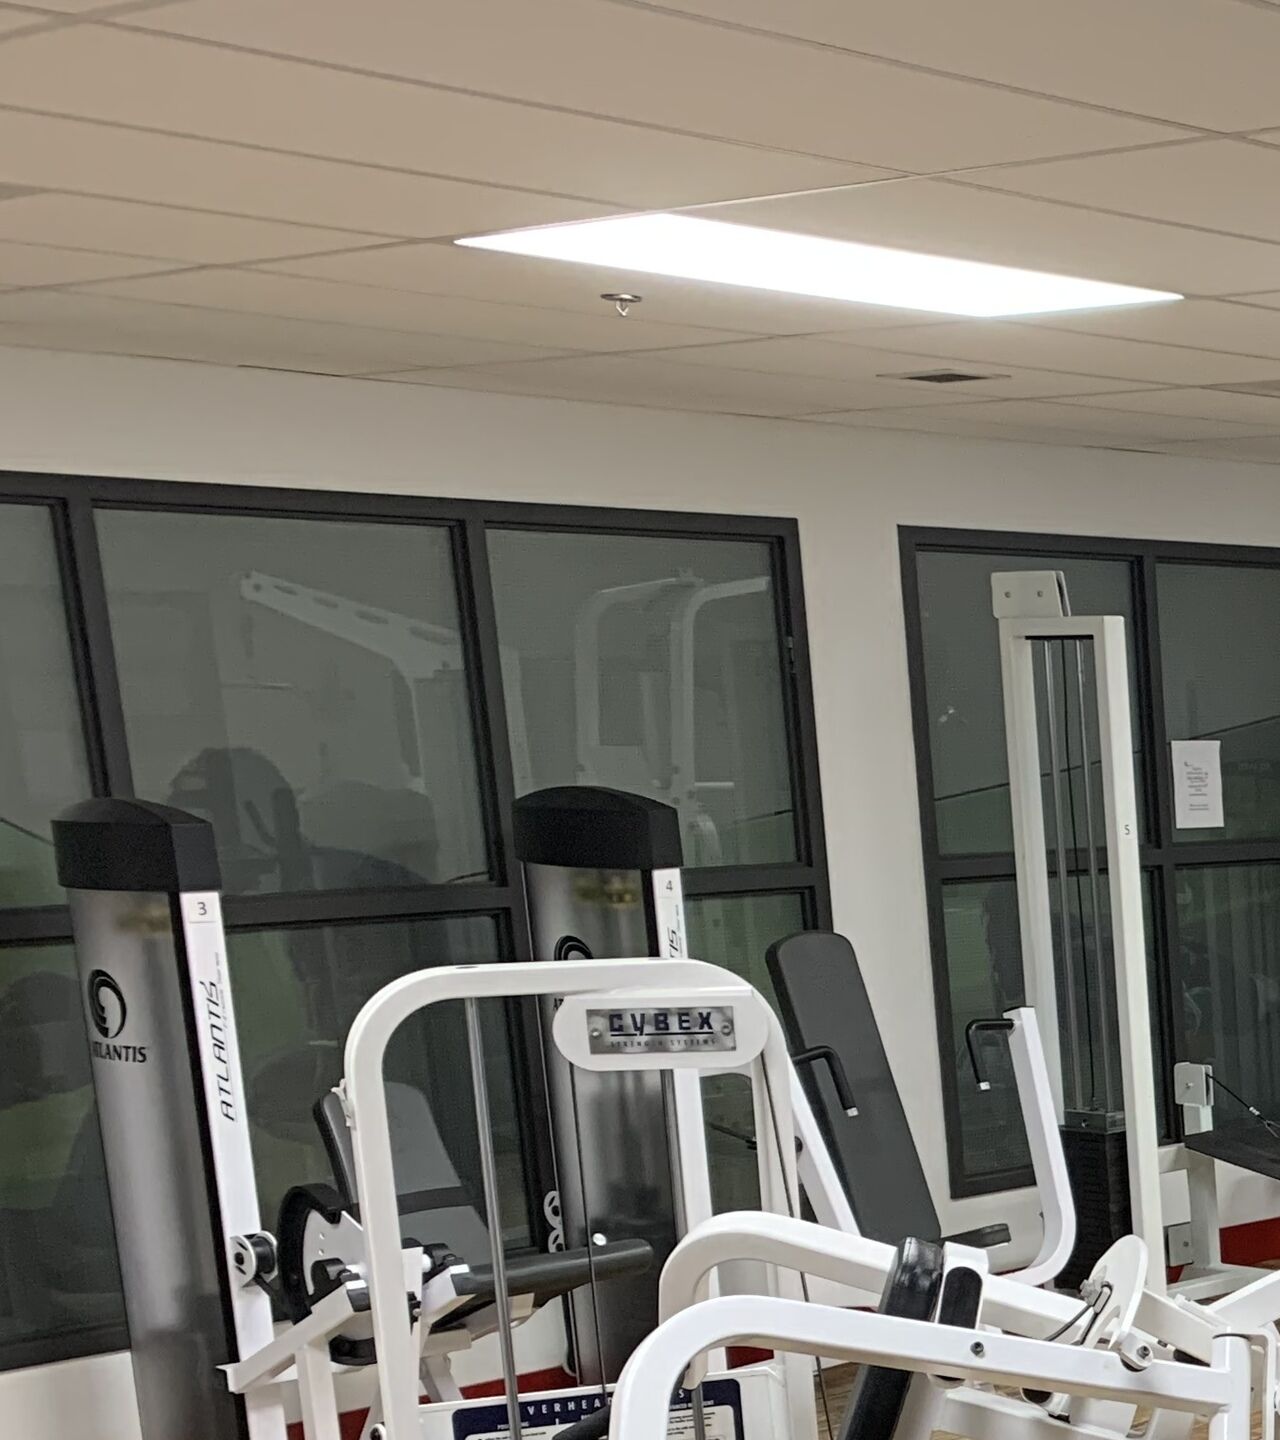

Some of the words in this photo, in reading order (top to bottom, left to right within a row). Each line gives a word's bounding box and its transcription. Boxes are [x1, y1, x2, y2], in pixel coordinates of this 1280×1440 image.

[665, 880, 674, 891] 4
[196, 902, 208, 916] 3
[200, 980, 236, 1121] ATLANTIS
[526, 1396, 613, 1415] VERHEA
